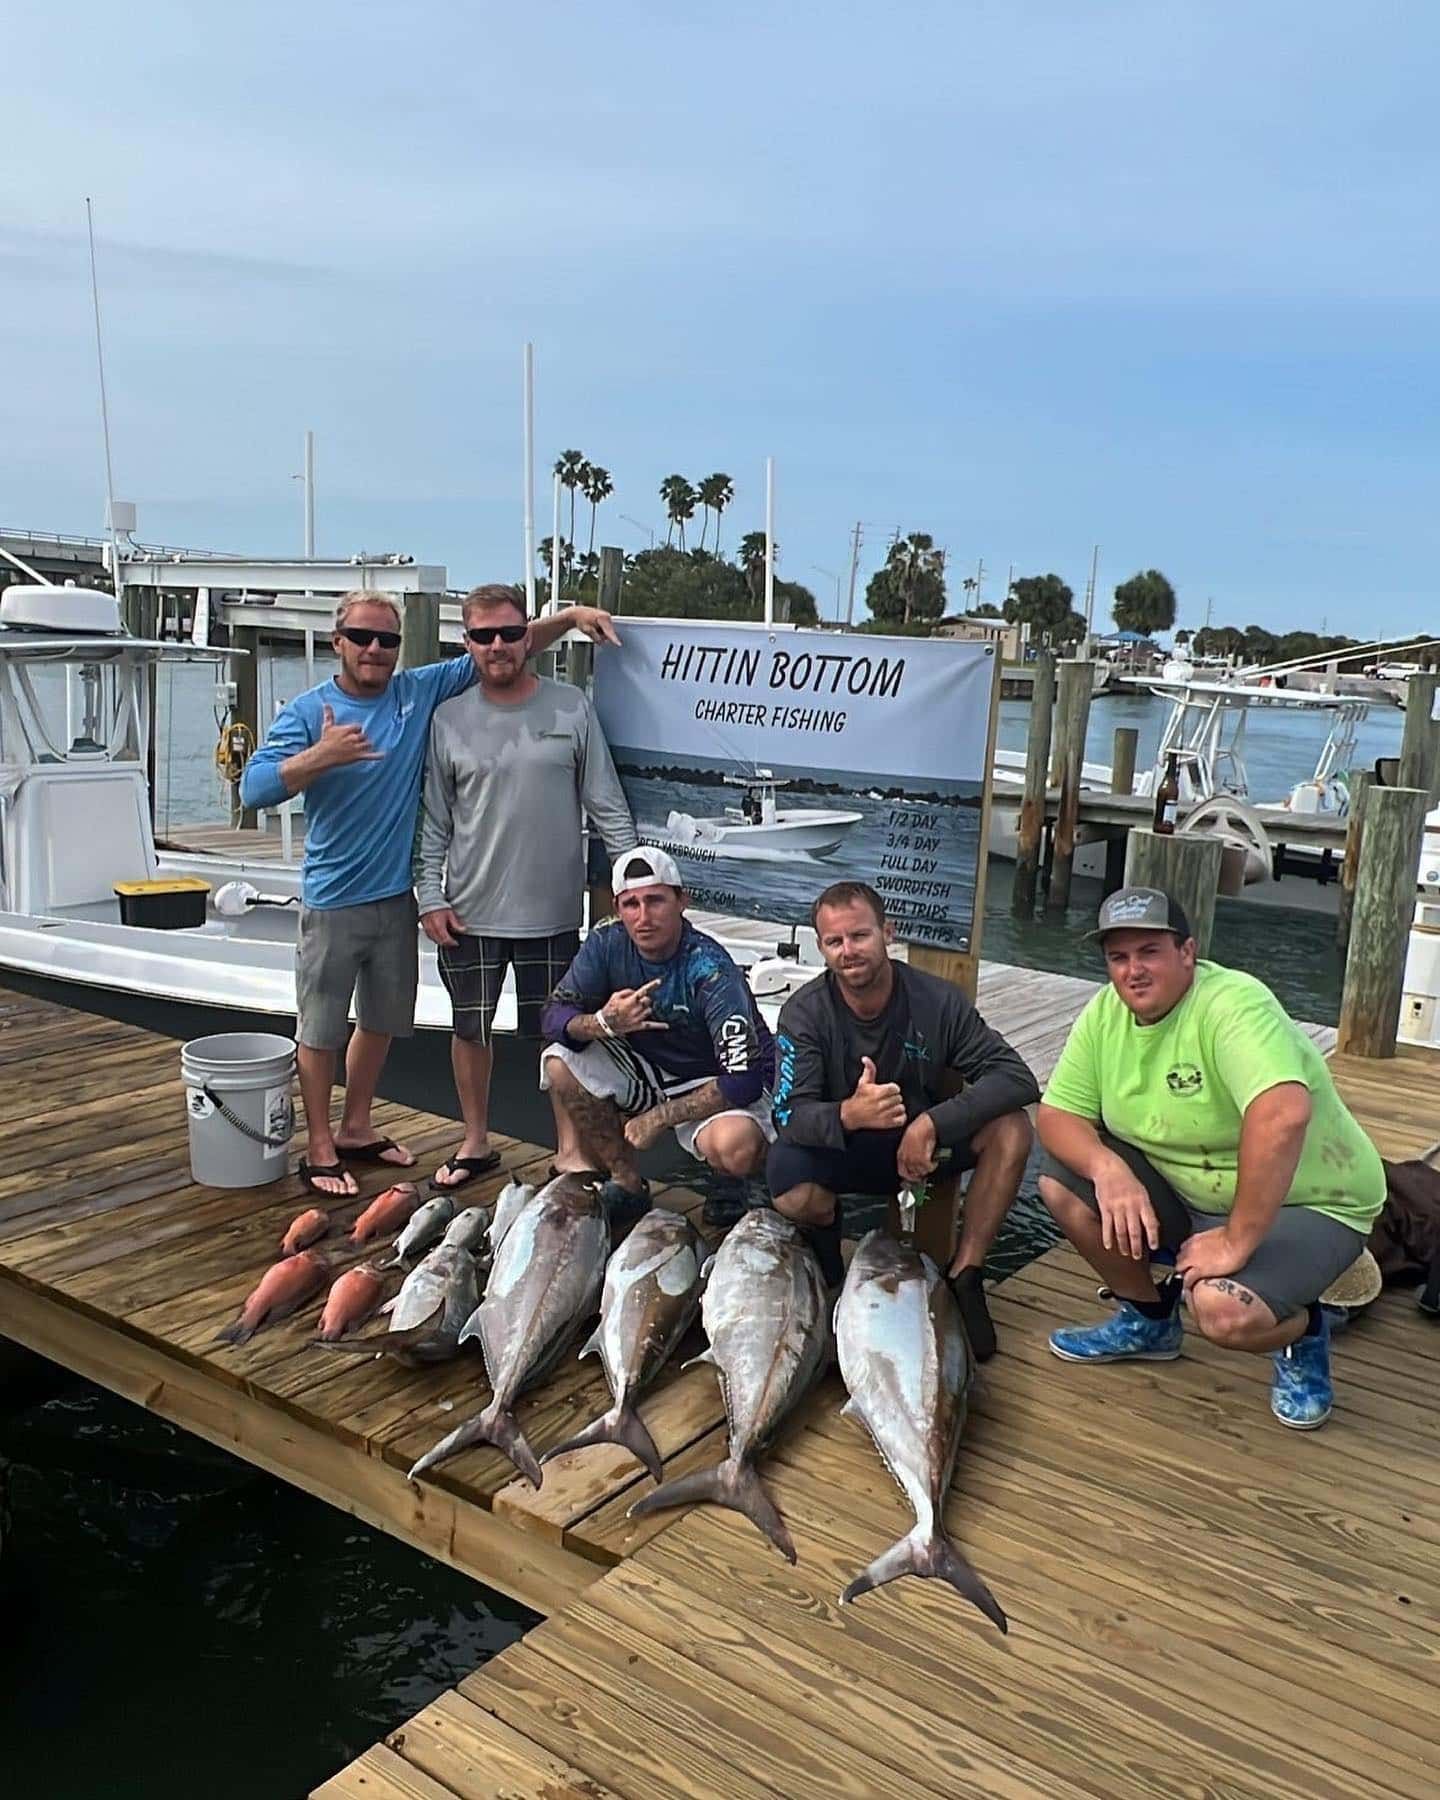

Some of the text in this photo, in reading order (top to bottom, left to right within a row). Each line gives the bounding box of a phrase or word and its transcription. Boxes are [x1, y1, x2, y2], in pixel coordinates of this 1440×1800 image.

[661, 643, 906, 698] HITTIN BOTTOM
[695, 699, 847, 733] CHARTER FISHING
[889, 810, 938, 831] 1/2 DAY
[886, 833, 940, 852] 3/4 DAY
[881, 854, 938, 875] FULL DAY
[875, 876, 952, 898] SWORDFISH
[881, 896, 950, 920] UNA TRIPS
[917, 925, 954, 942] TRIPS
